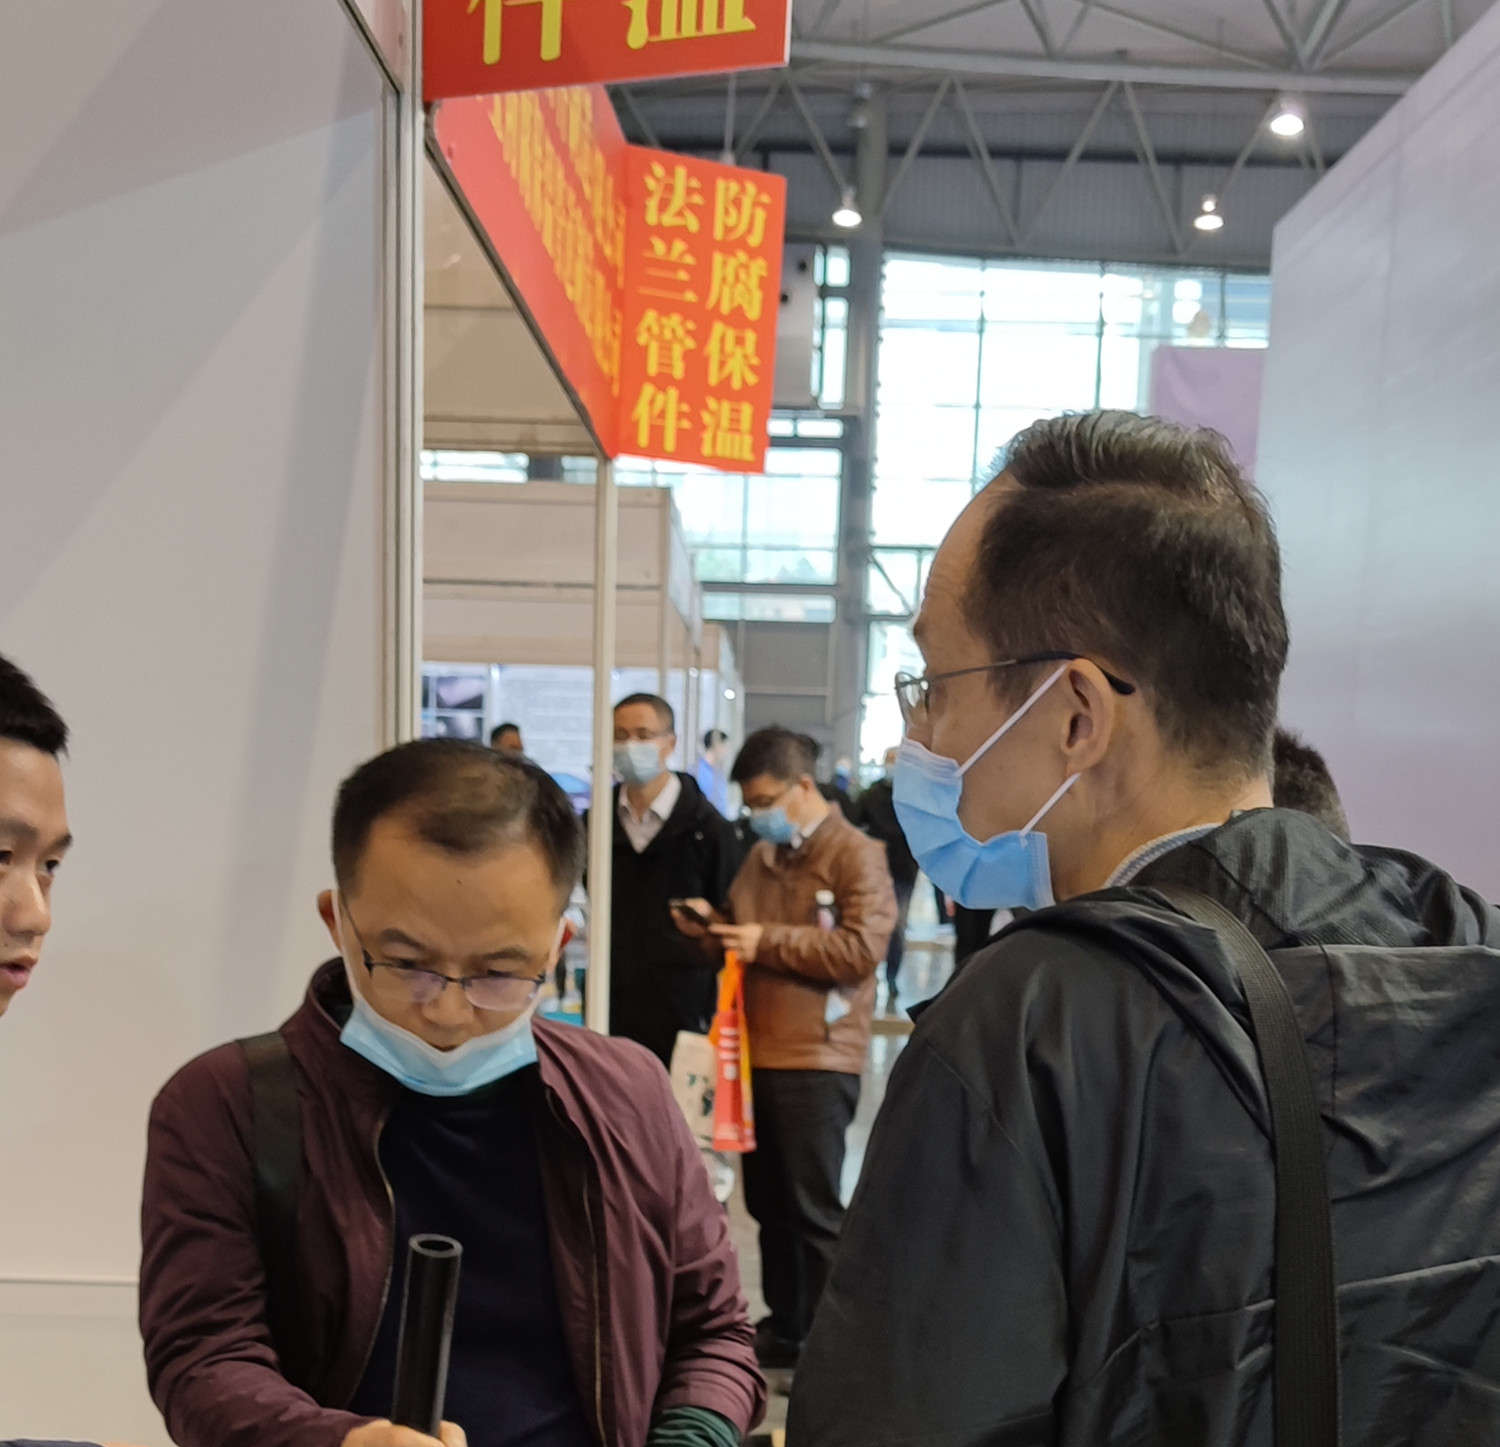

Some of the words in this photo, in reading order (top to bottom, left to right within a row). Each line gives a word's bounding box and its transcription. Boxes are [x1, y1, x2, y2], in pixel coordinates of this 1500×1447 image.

[631, 161, 705, 454] 法兰管件
[700, 177, 772, 463] 防腐保温
